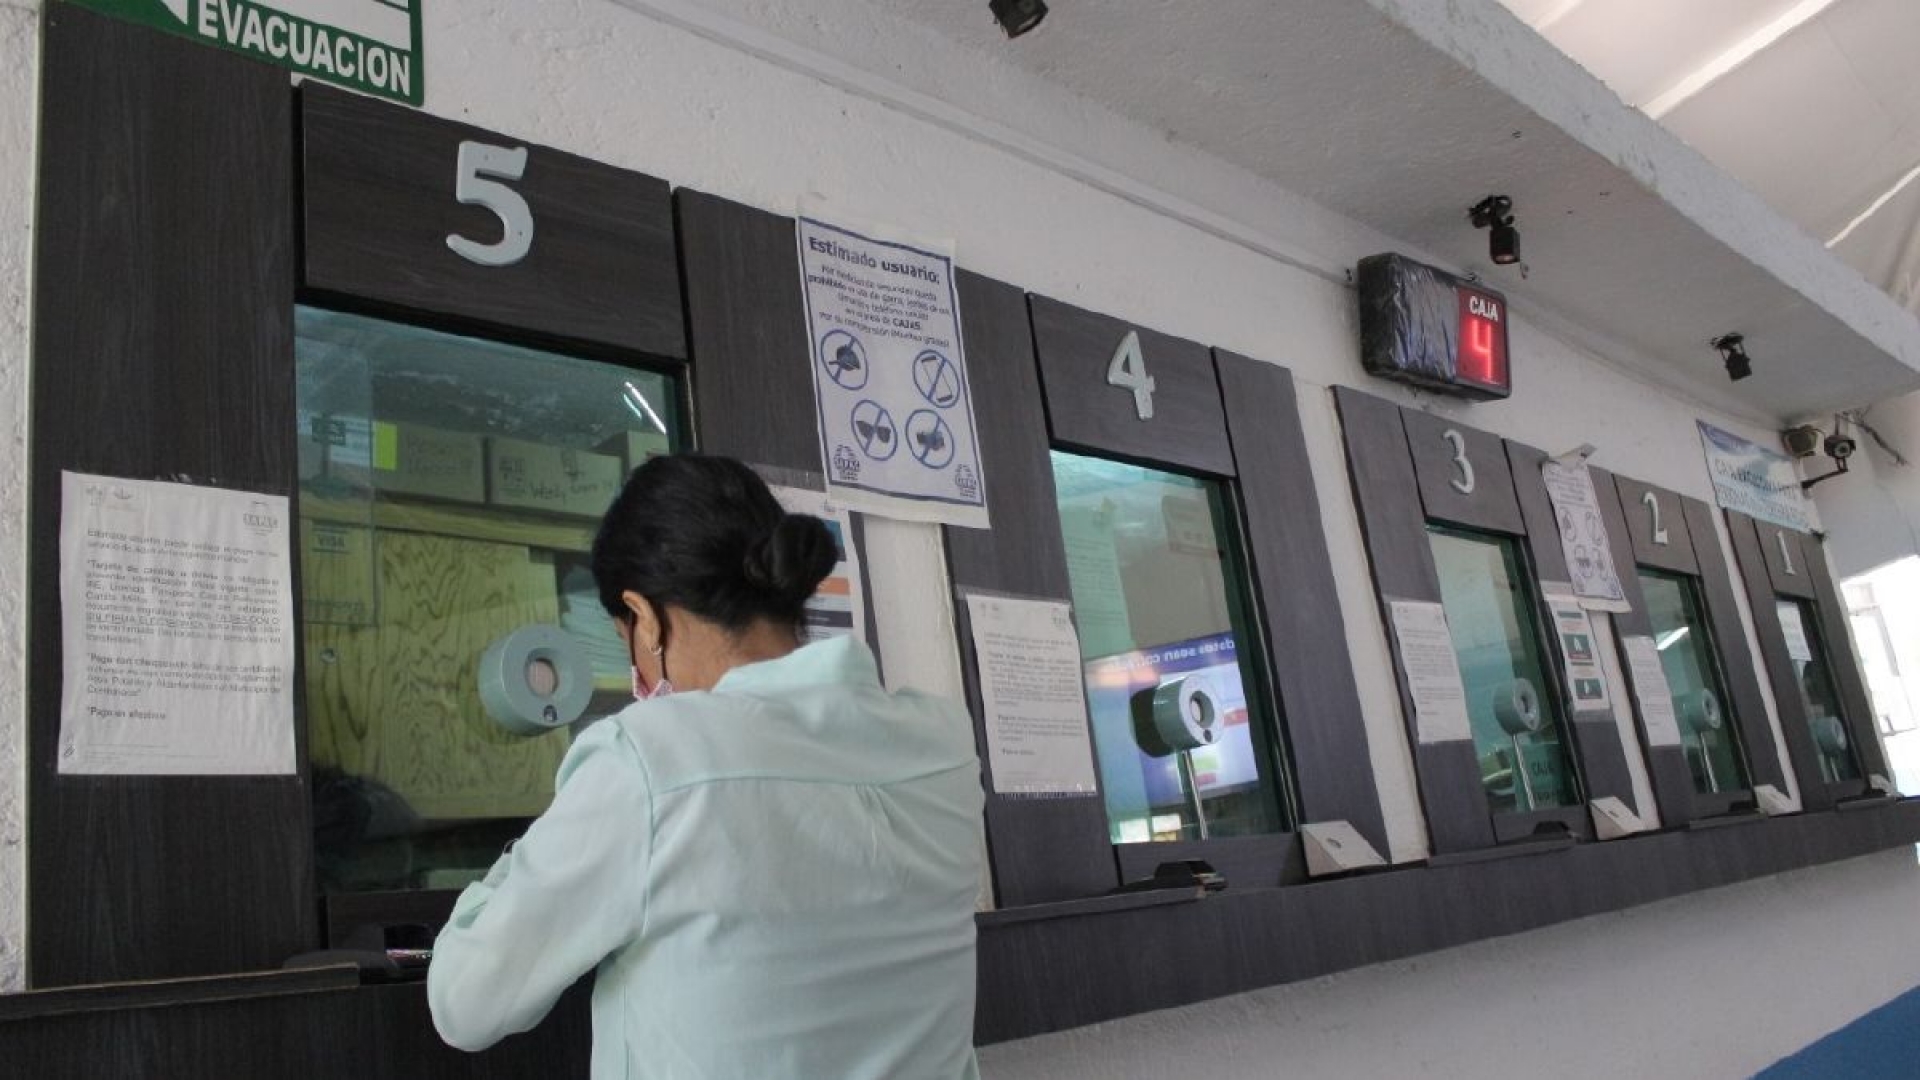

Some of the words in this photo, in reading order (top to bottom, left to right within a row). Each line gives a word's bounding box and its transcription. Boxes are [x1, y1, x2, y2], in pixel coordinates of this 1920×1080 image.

[198, 0, 411, 97] EVACUACION
[446, 140, 534, 266] 5
[809, 236, 877, 269] Estimado
[1469, 295, 1499, 322] CAJA
[1107, 331, 1155, 420] 4
[1472, 319, 1492, 380] 4
[1443, 429, 1475, 494] 3
[1642, 492, 1668, 545] 2
[1777, 530, 1796, 576] 1
